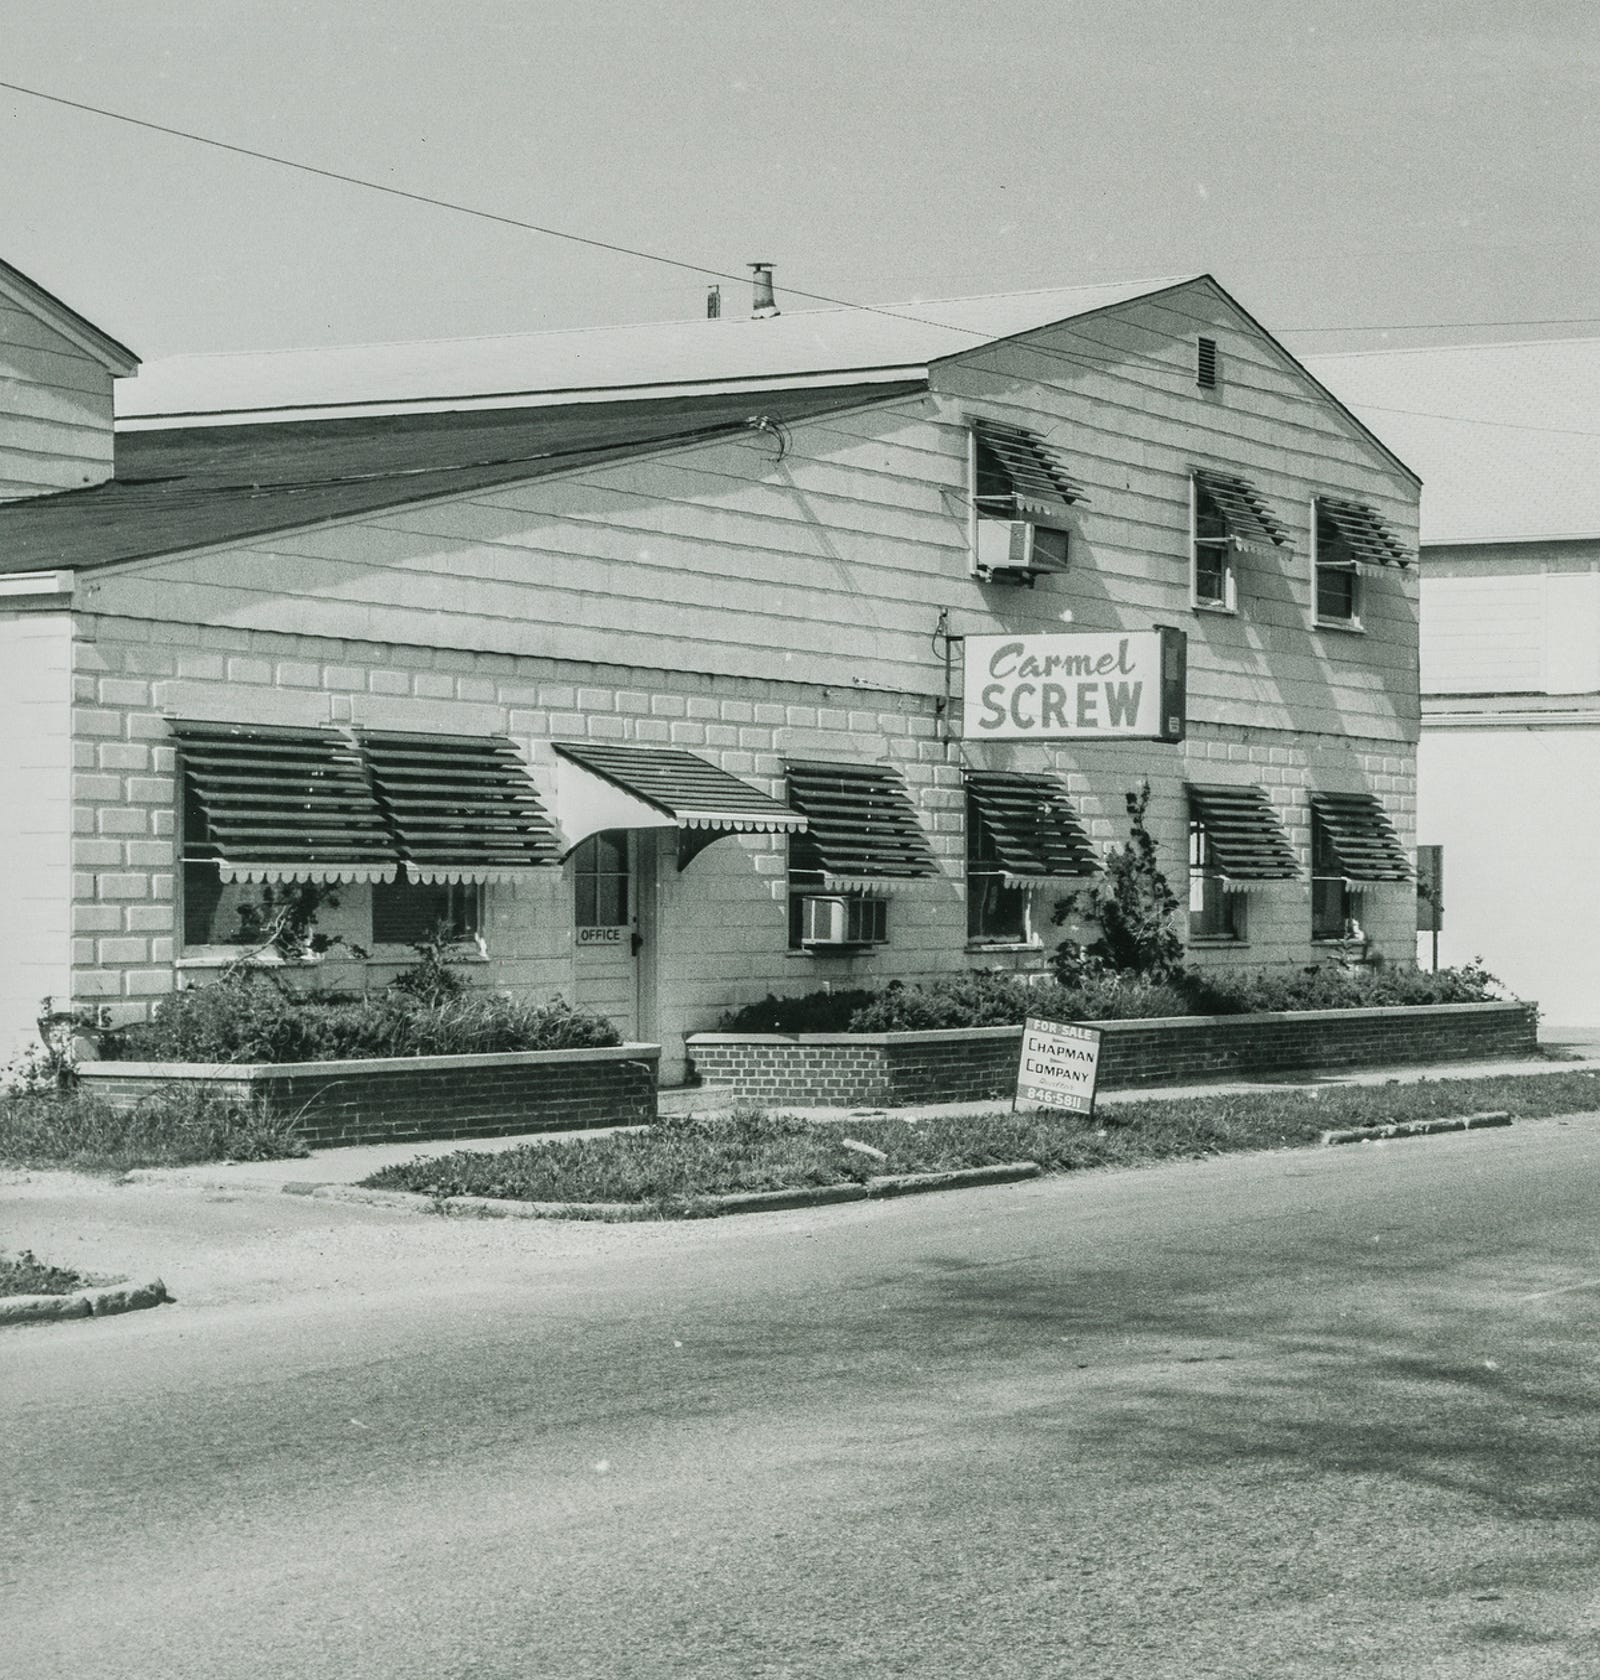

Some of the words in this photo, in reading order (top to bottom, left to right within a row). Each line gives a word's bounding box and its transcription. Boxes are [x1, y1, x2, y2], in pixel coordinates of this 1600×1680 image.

[988, 638, 1137, 680] Carmel
[978, 681, 1144, 730] SCREW
[580, 929, 620, 941] OFFICE
[1033, 1019, 1057, 1034] FOR
[1061, 1026, 1092, 1040] SALE
[1028, 1037, 1095, 1063] CHAPMAN
[1025, 1058, 1089, 1083] COMPANY
